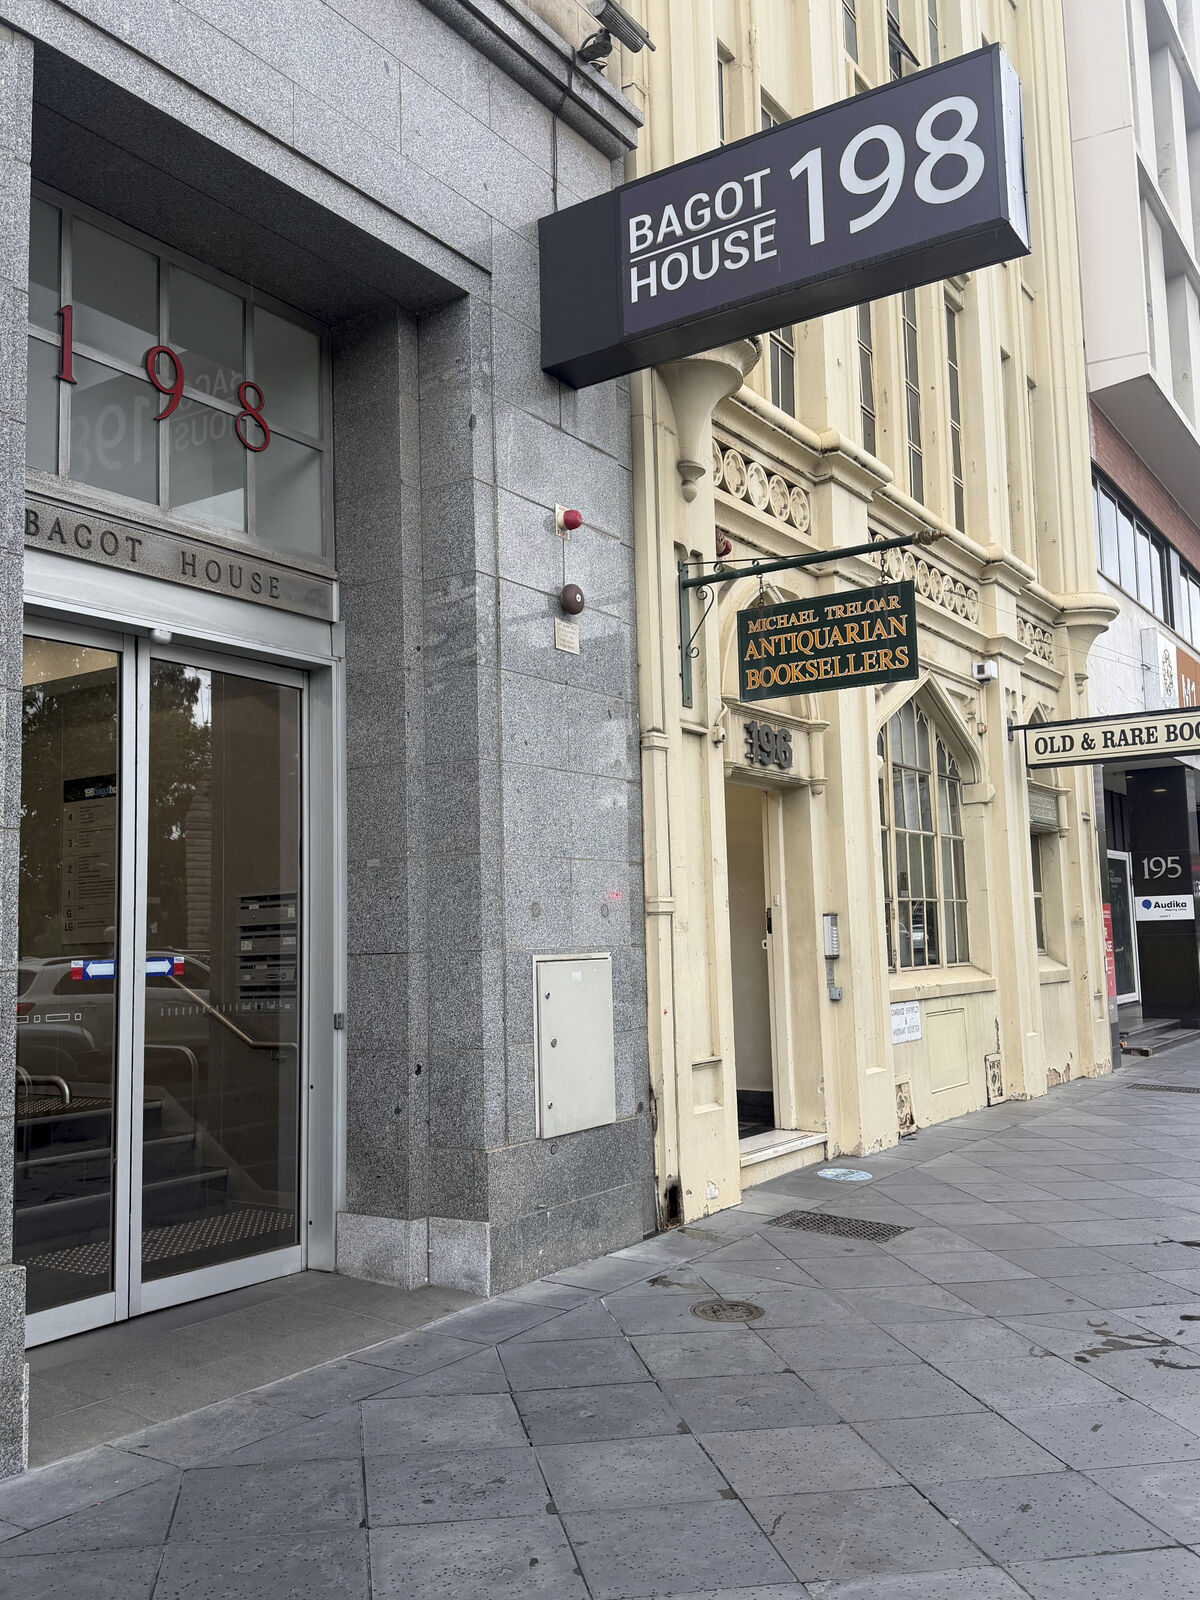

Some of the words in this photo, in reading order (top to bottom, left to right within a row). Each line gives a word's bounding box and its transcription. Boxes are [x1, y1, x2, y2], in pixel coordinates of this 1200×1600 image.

[789, 95, 985, 246] 198
[629, 167, 771, 254] BAGOT
[630, 218, 778, 303] HOUSE
[57, 304, 270, 452] 198
[25, 508, 142, 562] BAGOT
[180, 551, 280, 599] HOUSE
[744, 614, 908, 661] ANTIQUARIAN
[747, 610, 819, 634] MICHAEL
[825, 595, 901, 620] TRELOAR
[746, 646, 910, 690] BOOKSELLERS
[745, 720, 793, 769] 196
[1034, 734, 1075, 755] OLD
[1081, 732, 1096, 751] &
[1102, 726, 1158, 749] RARE
[1142, 856, 1182, 880] 195
[1153, 900, 1187, 909] Audika
